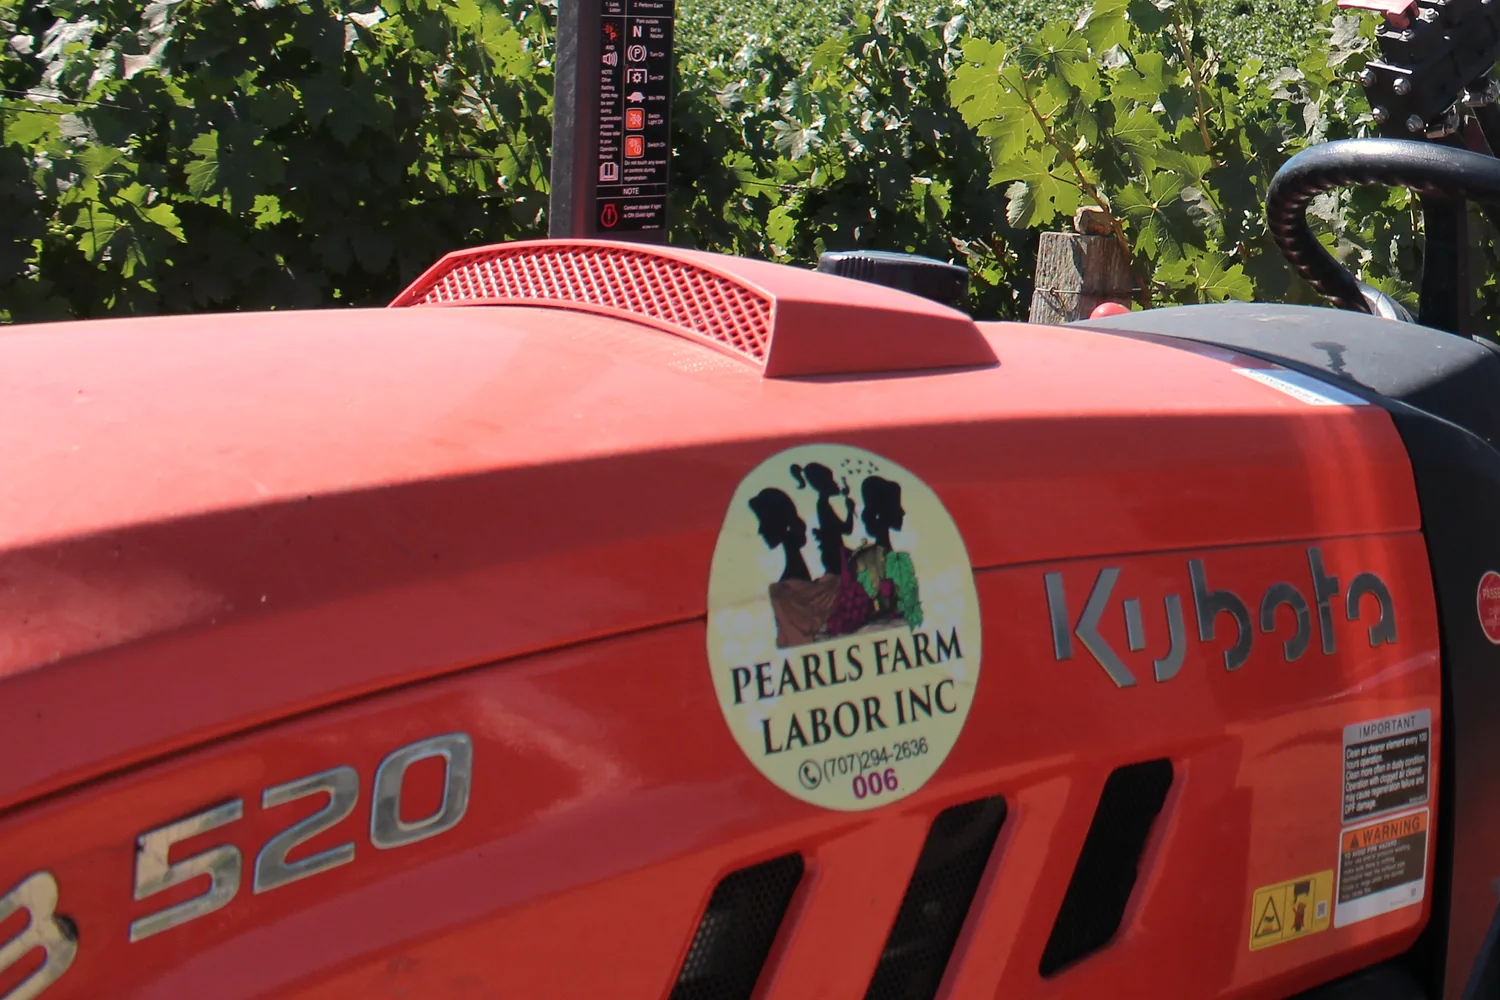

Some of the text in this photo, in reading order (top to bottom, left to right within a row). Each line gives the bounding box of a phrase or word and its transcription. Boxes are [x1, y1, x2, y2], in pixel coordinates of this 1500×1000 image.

[633, 26, 642, 37] N
[1043, 546, 1398, 688] Kubota
[729, 625, 965, 705] PEARLS FARM
[759, 678, 958, 757] LABOR INC
[1360, 716, 1415, 738] IMPORTANT
[823, 736, 929, 784] (707)294-2636
[1346, 749, 1360, 759] Clean
[1405, 737, 1418, 746] every
[851, 767, 899, 800] 006
[1346, 770, 1359, 780] Clean
[1345, 803, 1355, 814] DPF
[128, 732, 474, 943] 520
[1363, 817, 1420, 844] WARNING
